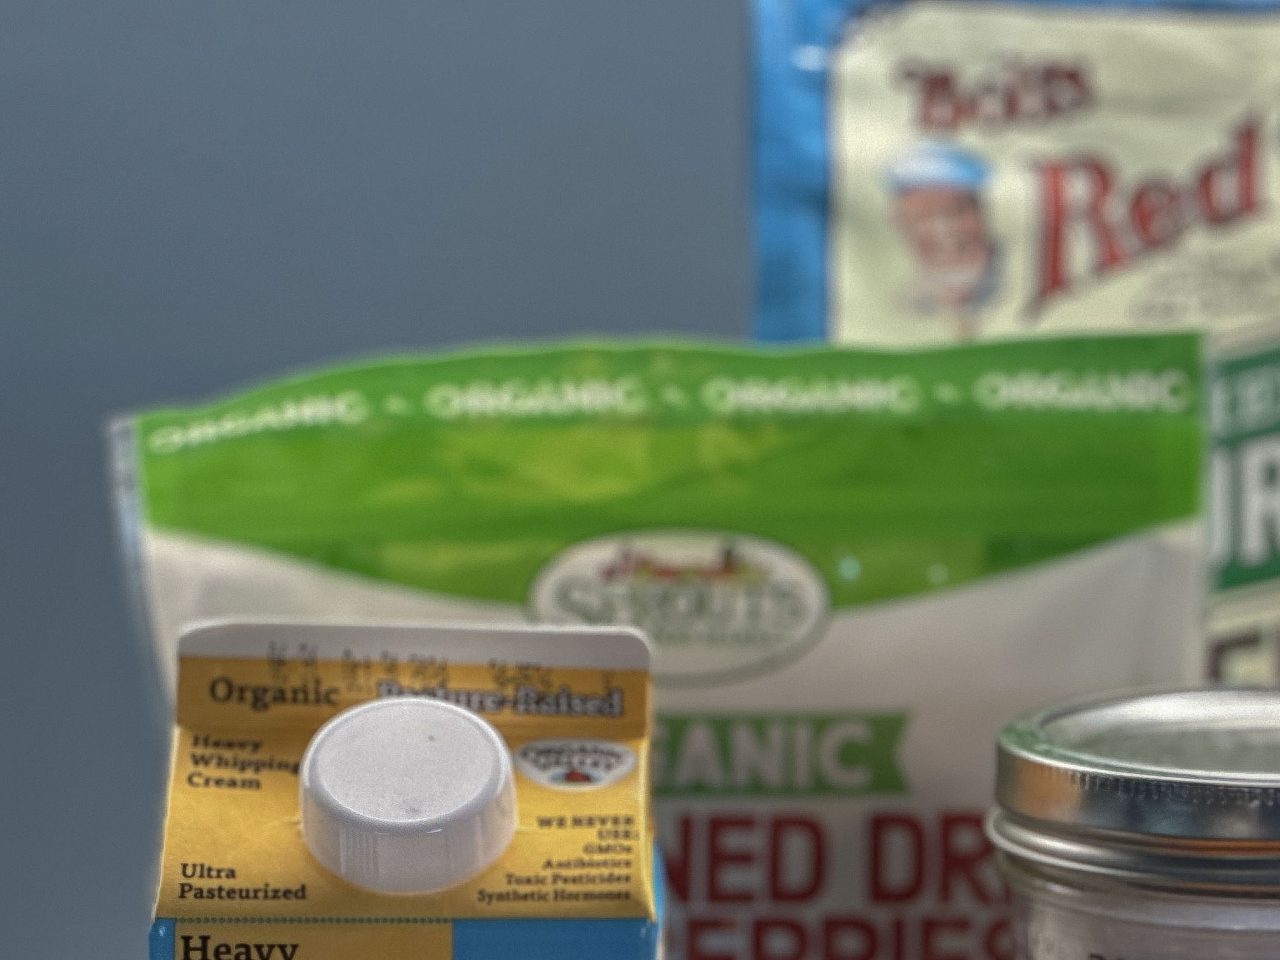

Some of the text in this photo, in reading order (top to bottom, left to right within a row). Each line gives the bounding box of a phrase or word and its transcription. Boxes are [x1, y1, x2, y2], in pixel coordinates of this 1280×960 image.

[1022, 125, 1264, 320] Red
[149, 371, 1191, 454] ORGANIC ORGANIC ORGANIC ORGANIC
[209, 677, 339, 713] Organic
[192, 734, 263, 752] Heavy
[187, 772, 262, 790] Cream
[542, 857, 632, 870] Antibiotics
[869, 811, 1010, 905] DR
[180, 862, 236, 880] Ultra
[506, 873, 632, 886] Toxic Pesticides
[178, 883, 307, 900] Pasteurized
[478, 889, 631, 904] Synthetic Hormones
